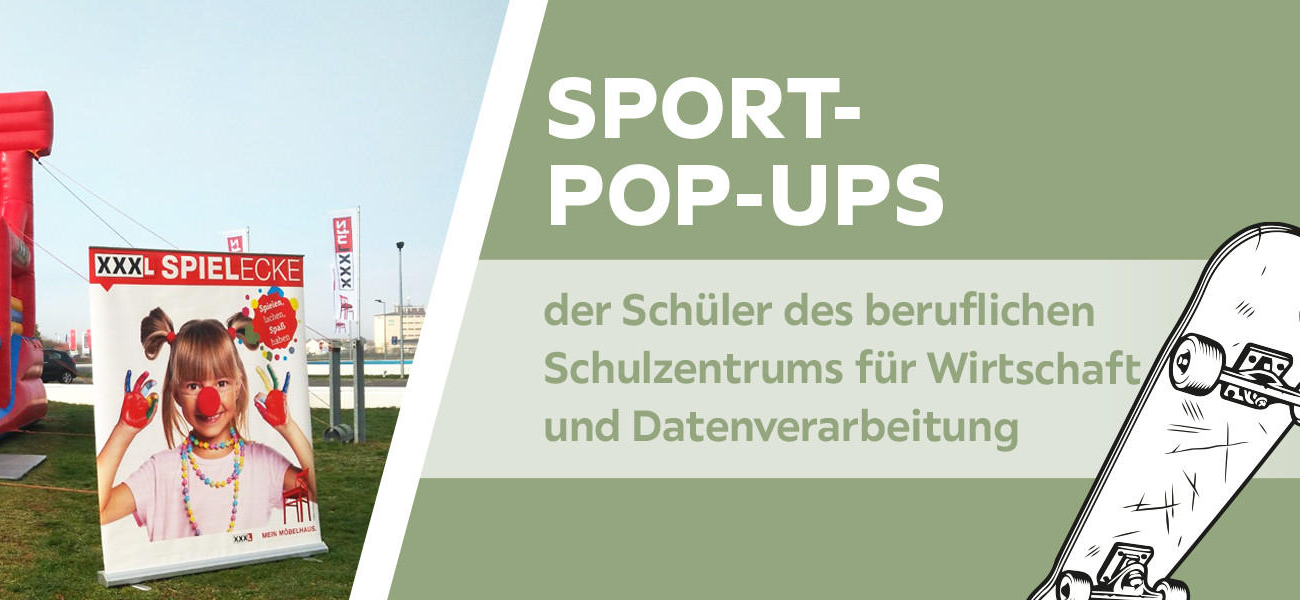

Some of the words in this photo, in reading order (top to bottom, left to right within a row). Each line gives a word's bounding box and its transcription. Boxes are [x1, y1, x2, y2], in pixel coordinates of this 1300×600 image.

[96, 256, 154, 276] XXXL
[162, 254, 301, 282] SPIELECKE
[261, 531, 278, 539] MEIN
